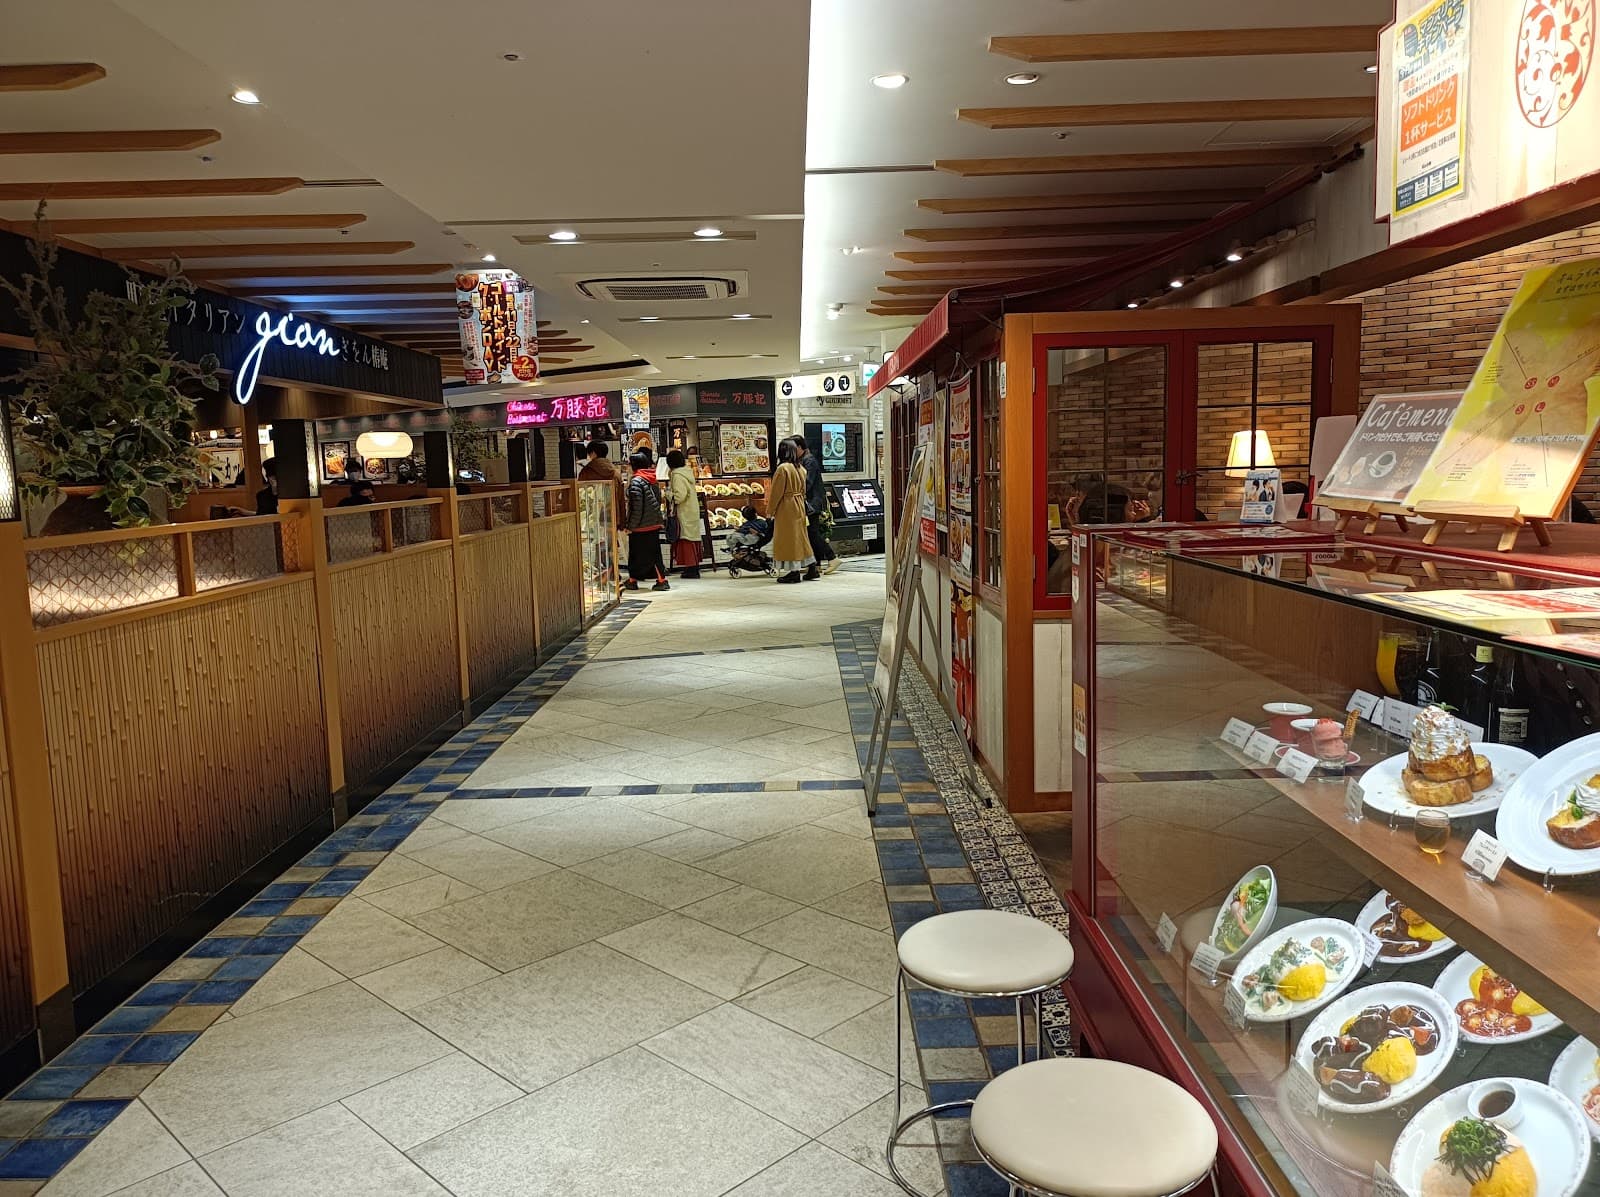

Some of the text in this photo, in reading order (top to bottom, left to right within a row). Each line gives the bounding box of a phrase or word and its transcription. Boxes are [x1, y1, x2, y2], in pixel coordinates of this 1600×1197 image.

[1403, 81, 1455, 124] ソフトドリンク
[1404, 107, 1452, 145] 1杯サービス
